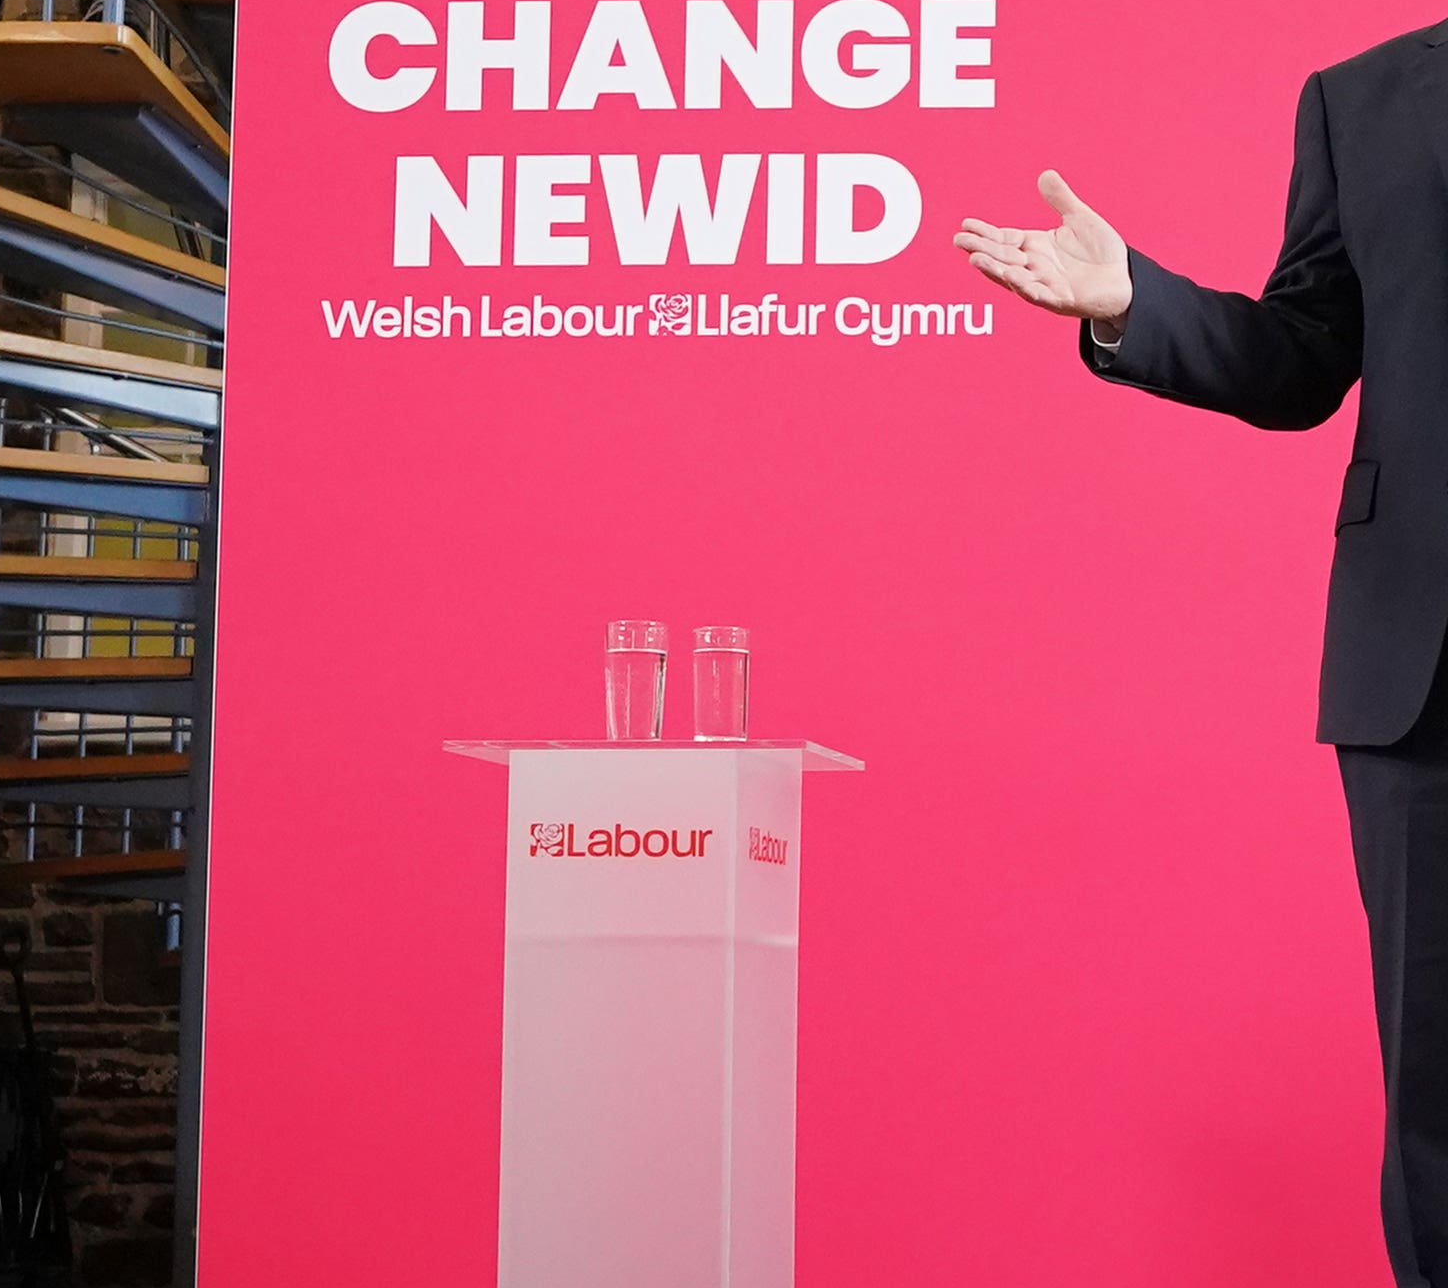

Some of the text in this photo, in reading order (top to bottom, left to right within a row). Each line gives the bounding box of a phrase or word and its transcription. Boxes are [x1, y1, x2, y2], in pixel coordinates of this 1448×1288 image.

[393, 153, 922, 267] NEWID
[321, 293, 993, 345] Welsh Labour Llafur Cymru
[568, 823, 712, 857] Labour
